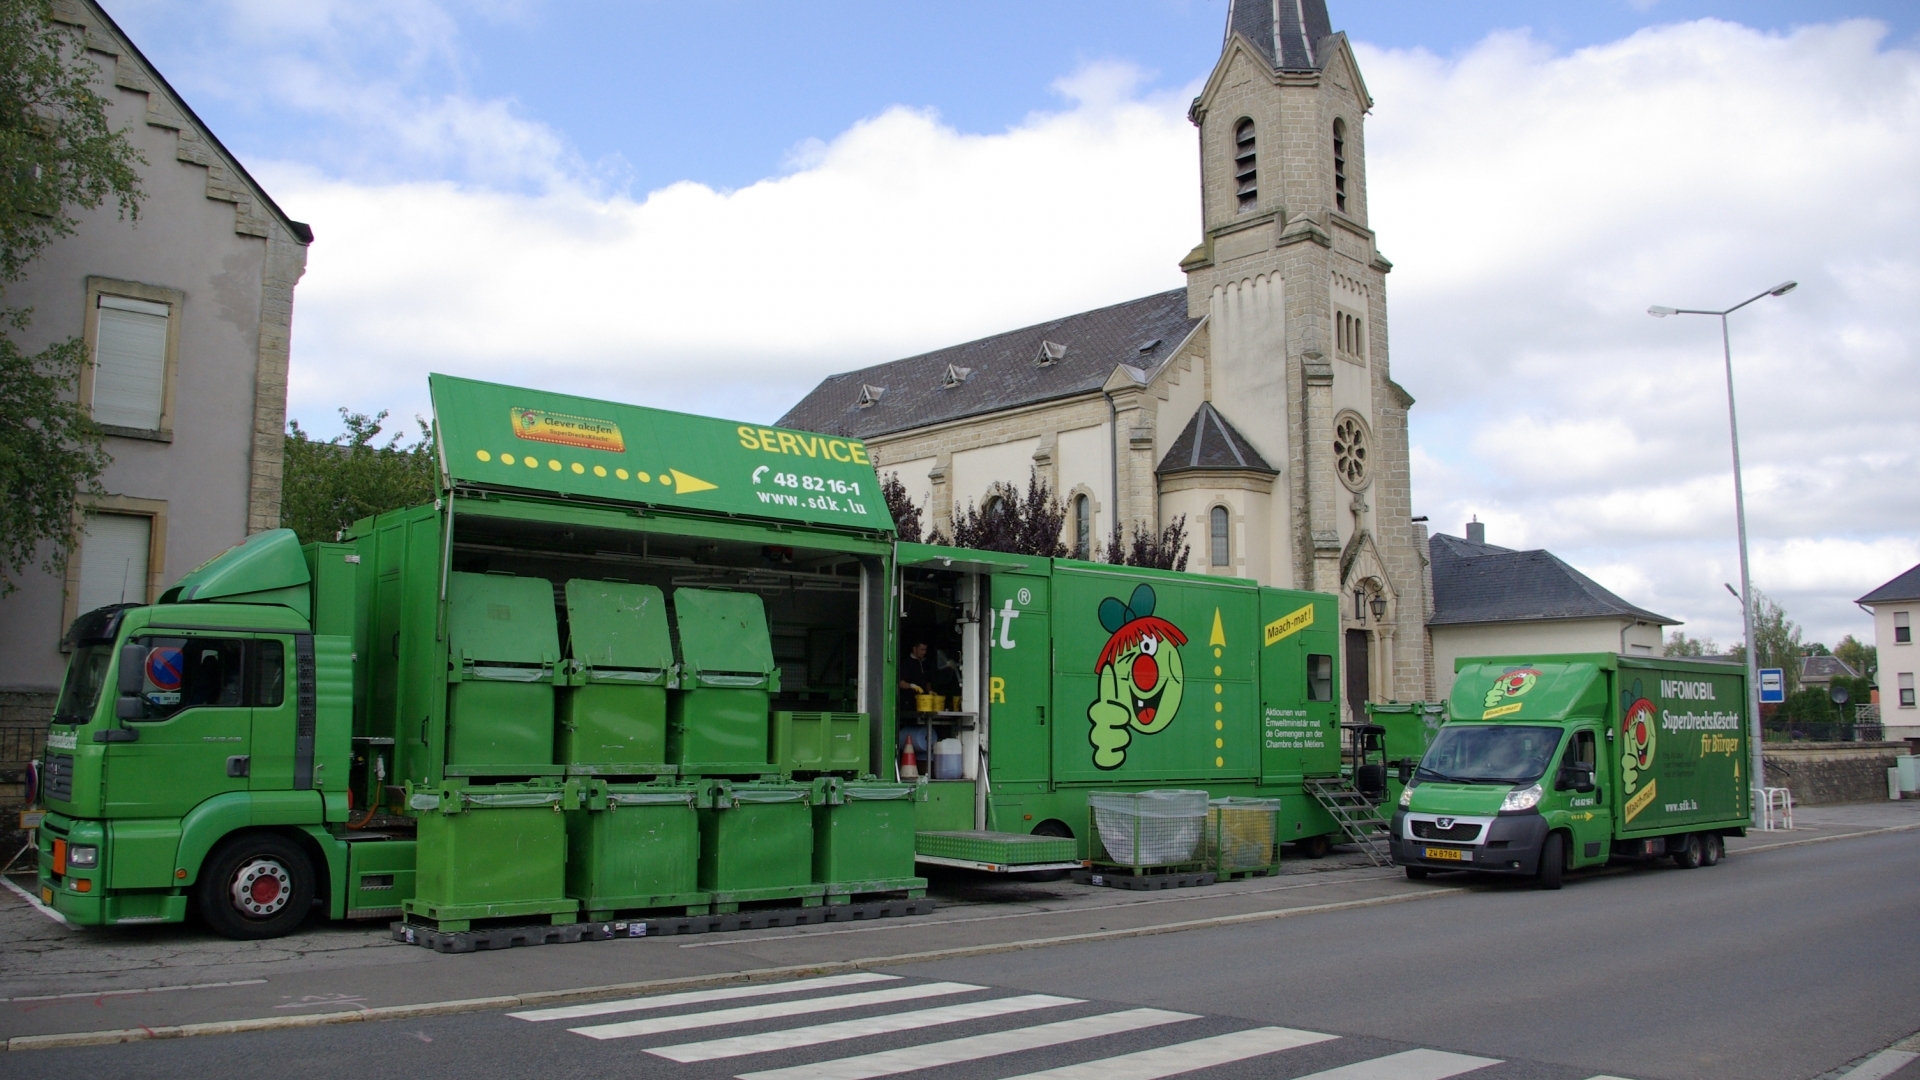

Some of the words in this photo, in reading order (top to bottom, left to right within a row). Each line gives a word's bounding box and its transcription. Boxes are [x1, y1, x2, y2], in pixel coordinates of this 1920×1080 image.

[544, 417, 576, 429] Clever
[578, 423, 612, 434] akafen
[737, 426, 870, 465] SERVICE
[773, 472, 799, 488] 48
[801, 476, 826, 492] 82
[826, 479, 861, 496] 16-1
[756, 491, 867, 514] www.sdk.lu
[1661, 679, 1716, 700] INFOMOBIL
[1265, 708, 1293, 717] Aktiounen
[1309, 719, 1321, 728] mat
[1265, 729, 1274, 738] de
[1274, 729, 1305, 740] Gemengen
[1314, 730, 1323, 738] der
[1265, 740, 1292, 749] Chambre
[1292, 741, 1303, 749] des
[1712, 733, 1739, 757] Bürger
[1428, 849, 1438, 857] ZW
